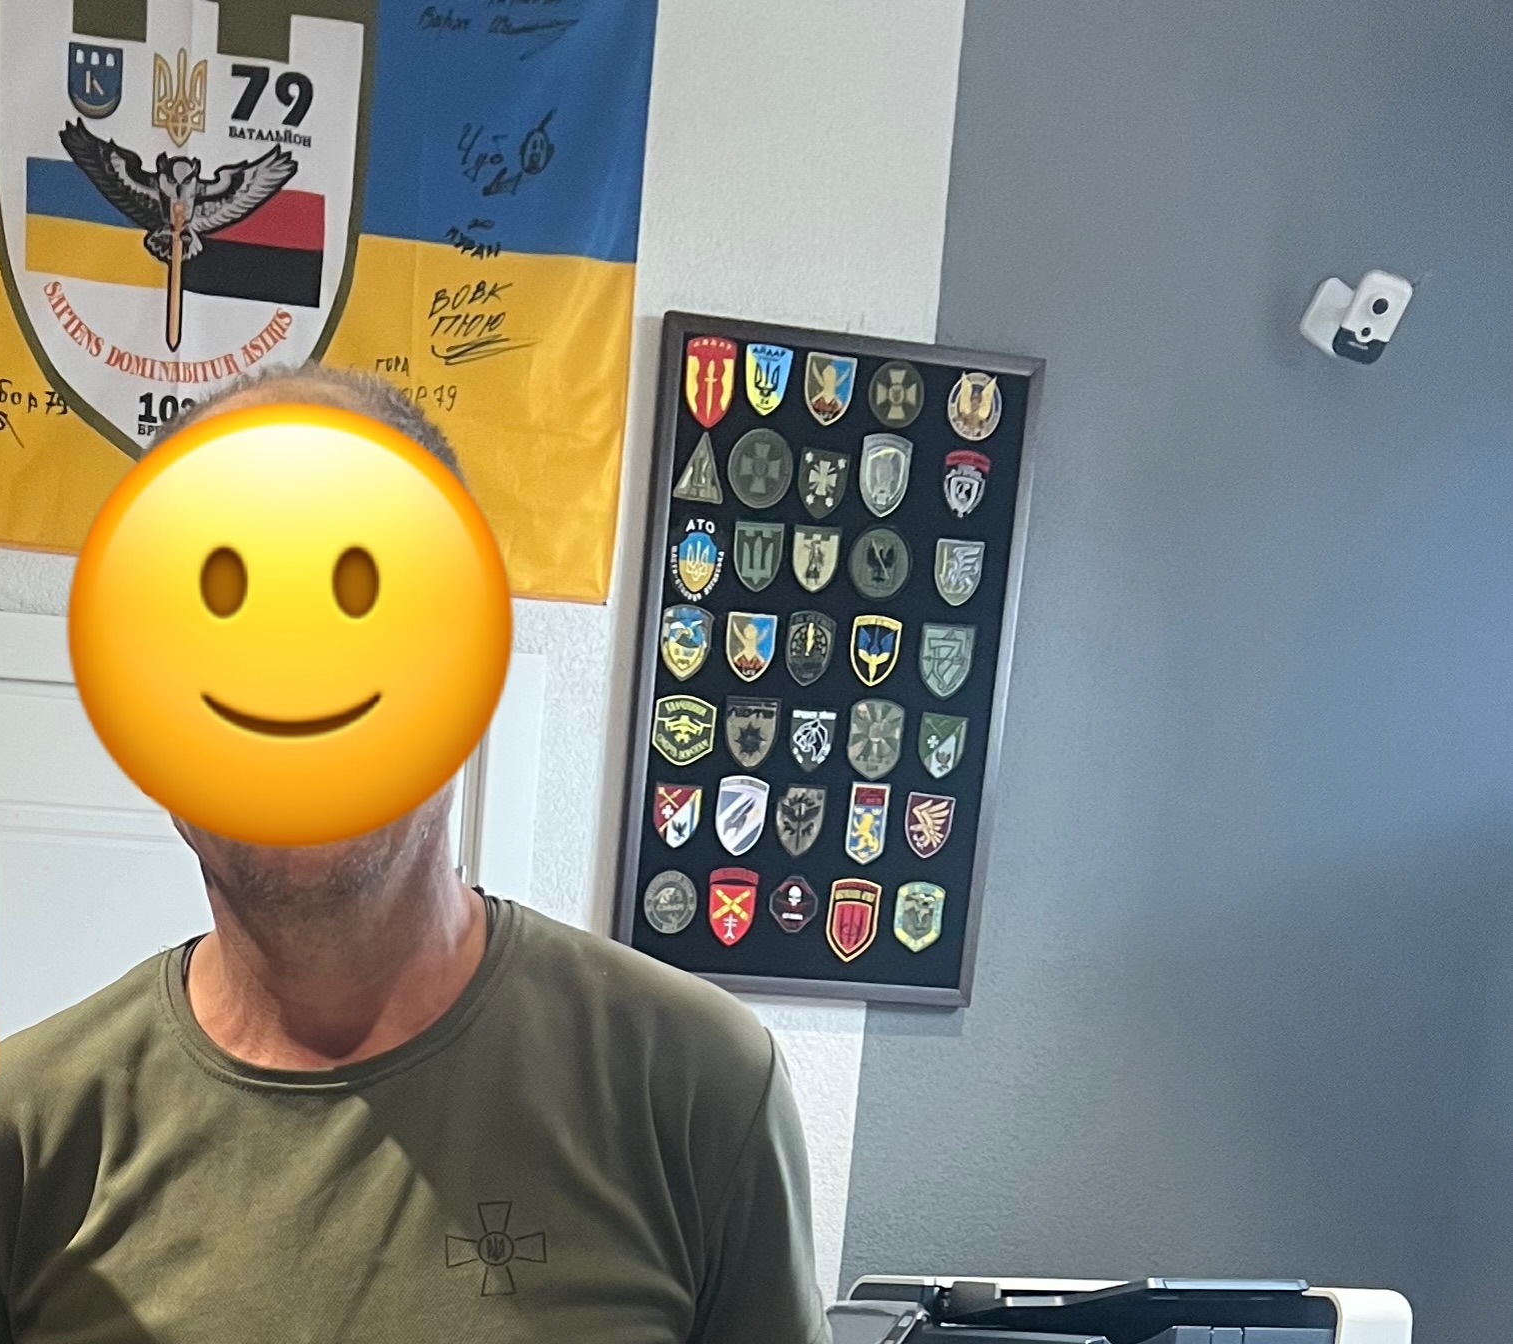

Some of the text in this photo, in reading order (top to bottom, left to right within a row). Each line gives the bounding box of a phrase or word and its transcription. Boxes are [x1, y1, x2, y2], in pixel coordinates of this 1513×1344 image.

[231, 64, 314, 128] 79
[428, 280, 513, 319] ВОВК
[43, 281, 105, 358] SAPIENS
[104, 344, 241, 384] DOMINABITUR
[44, 391, 69, 415] 79
[433, 384, 458, 411] 79
[685, 518, 715, 534] АТО
